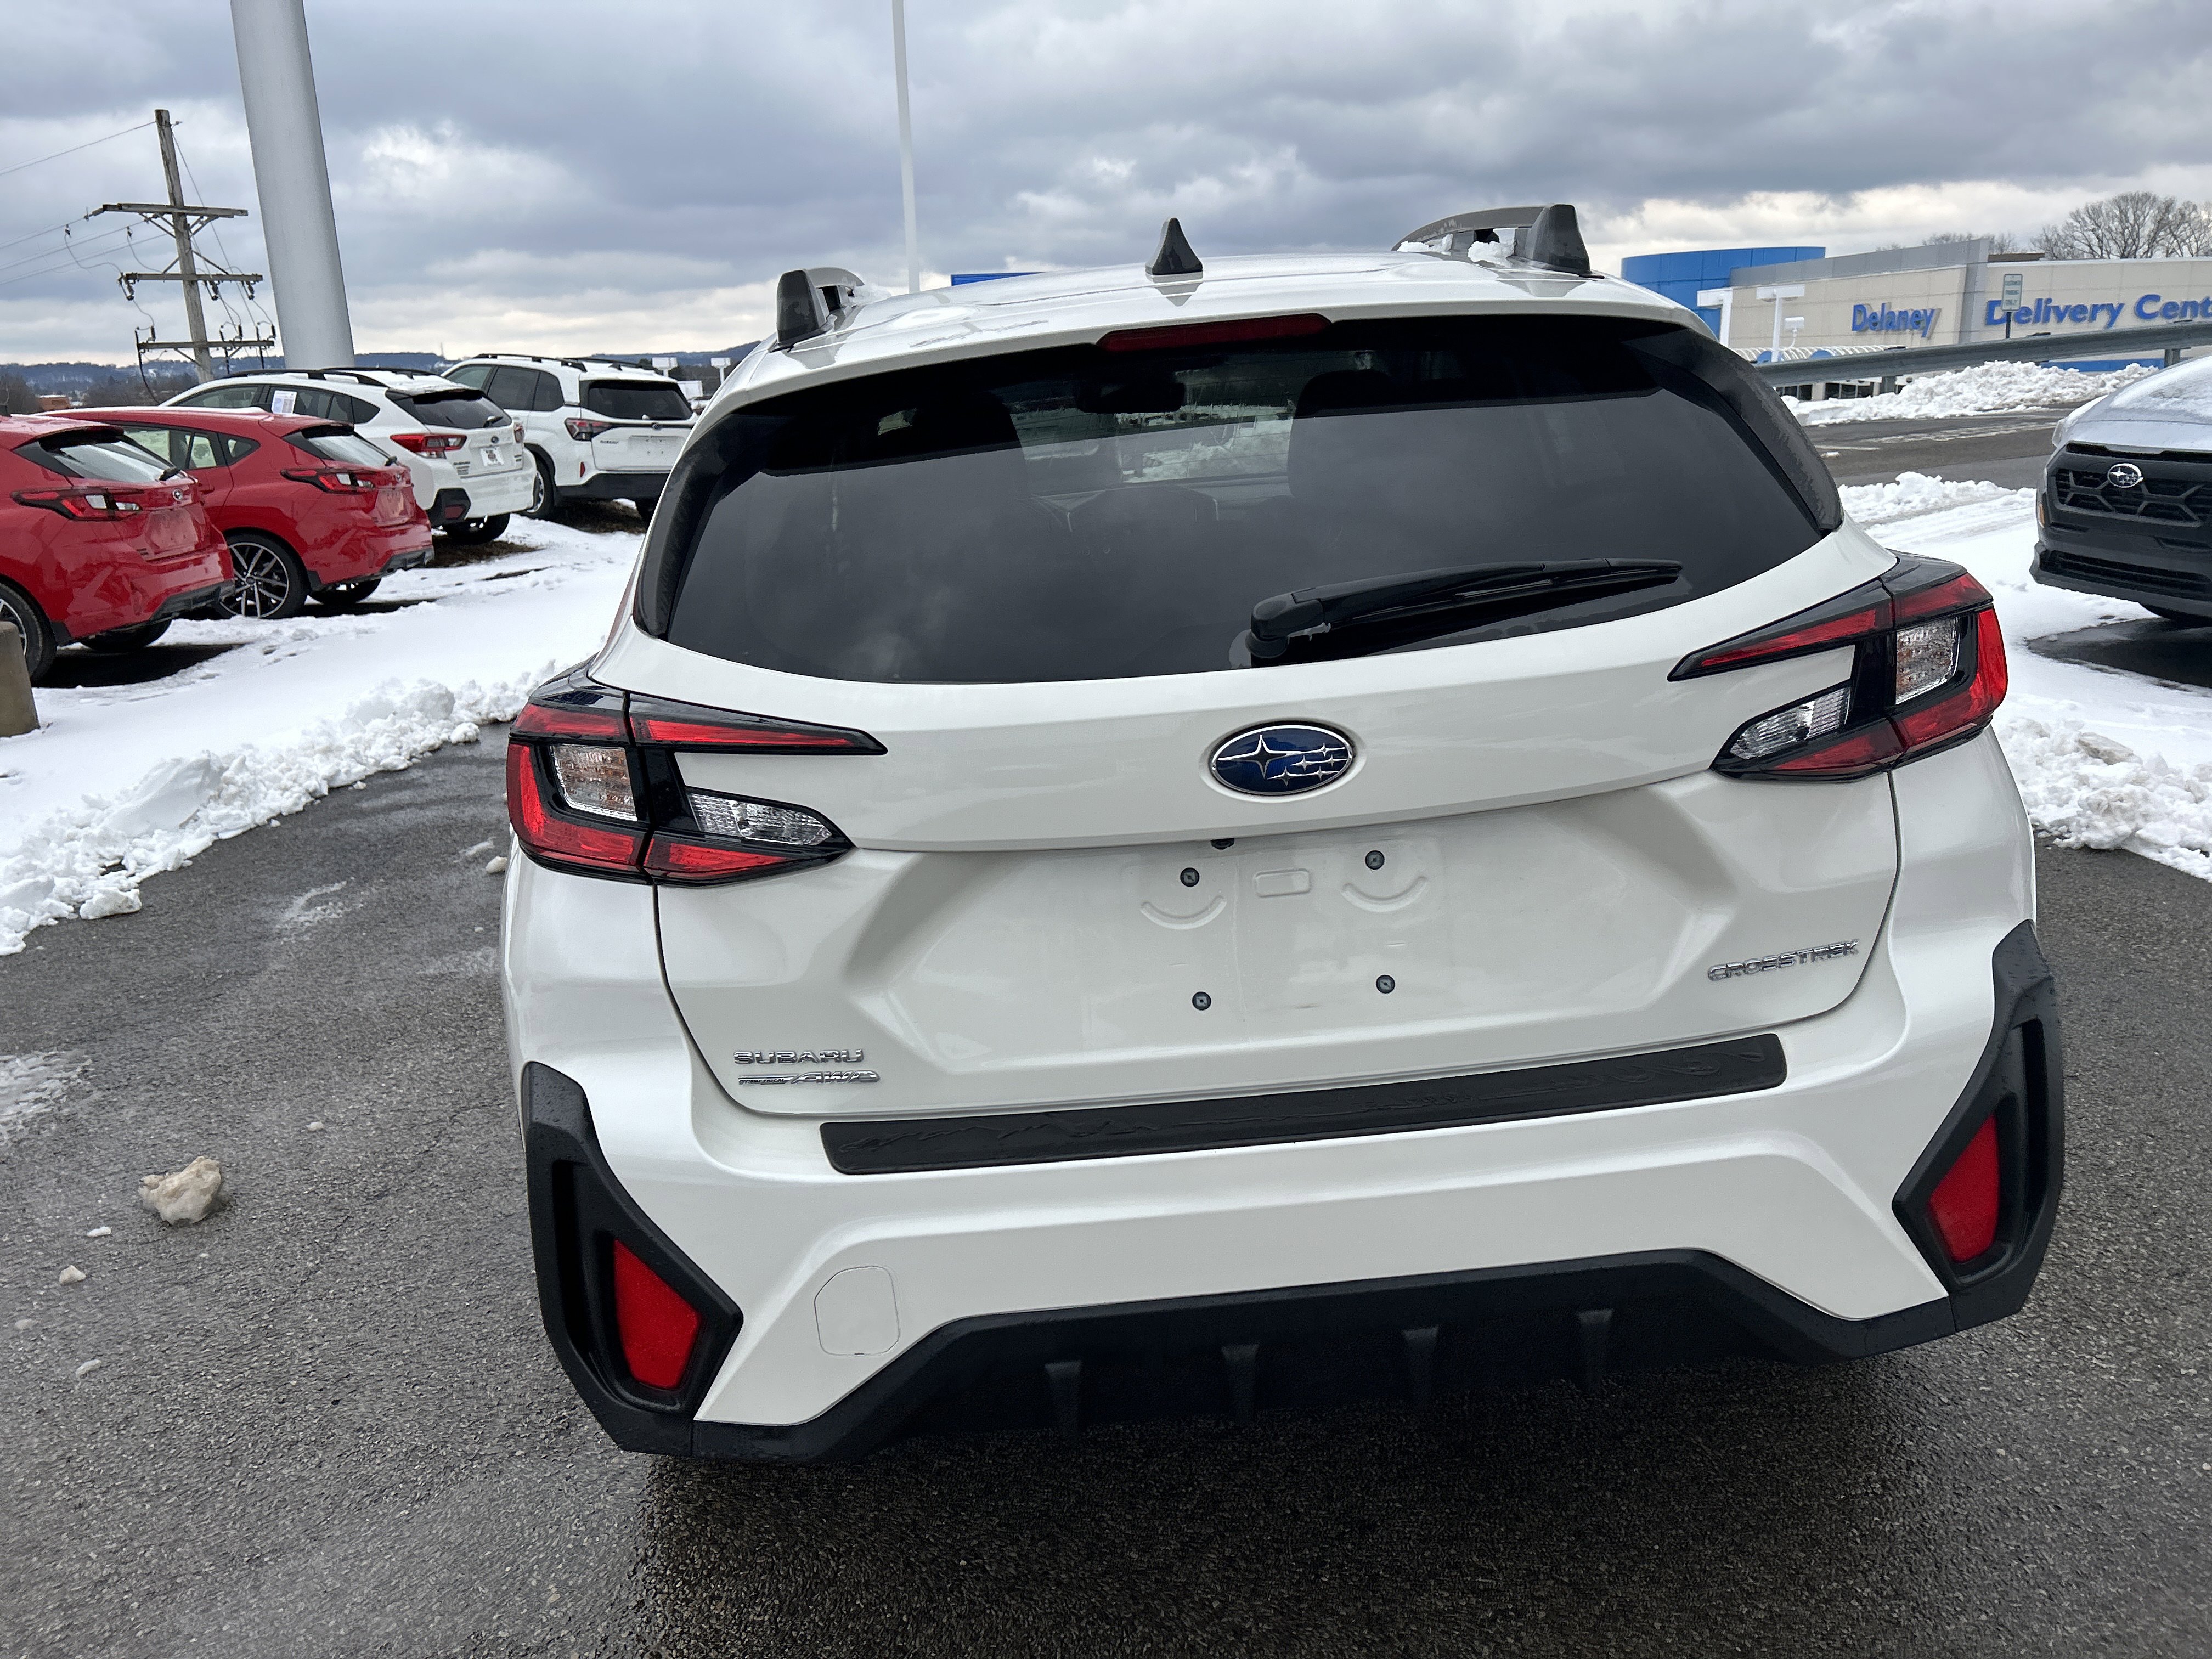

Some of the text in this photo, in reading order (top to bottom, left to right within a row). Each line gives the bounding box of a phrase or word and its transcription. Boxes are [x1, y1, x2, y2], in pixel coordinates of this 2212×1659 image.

[1852, 302, 1940, 339] Delaney
[1985, 297, 2125, 330] Delivery
[1707, 939, 1860, 981] CROSSTREK
[733, 1048, 865, 1064] SUBARU
[791, 1070, 880, 1085] AWD
